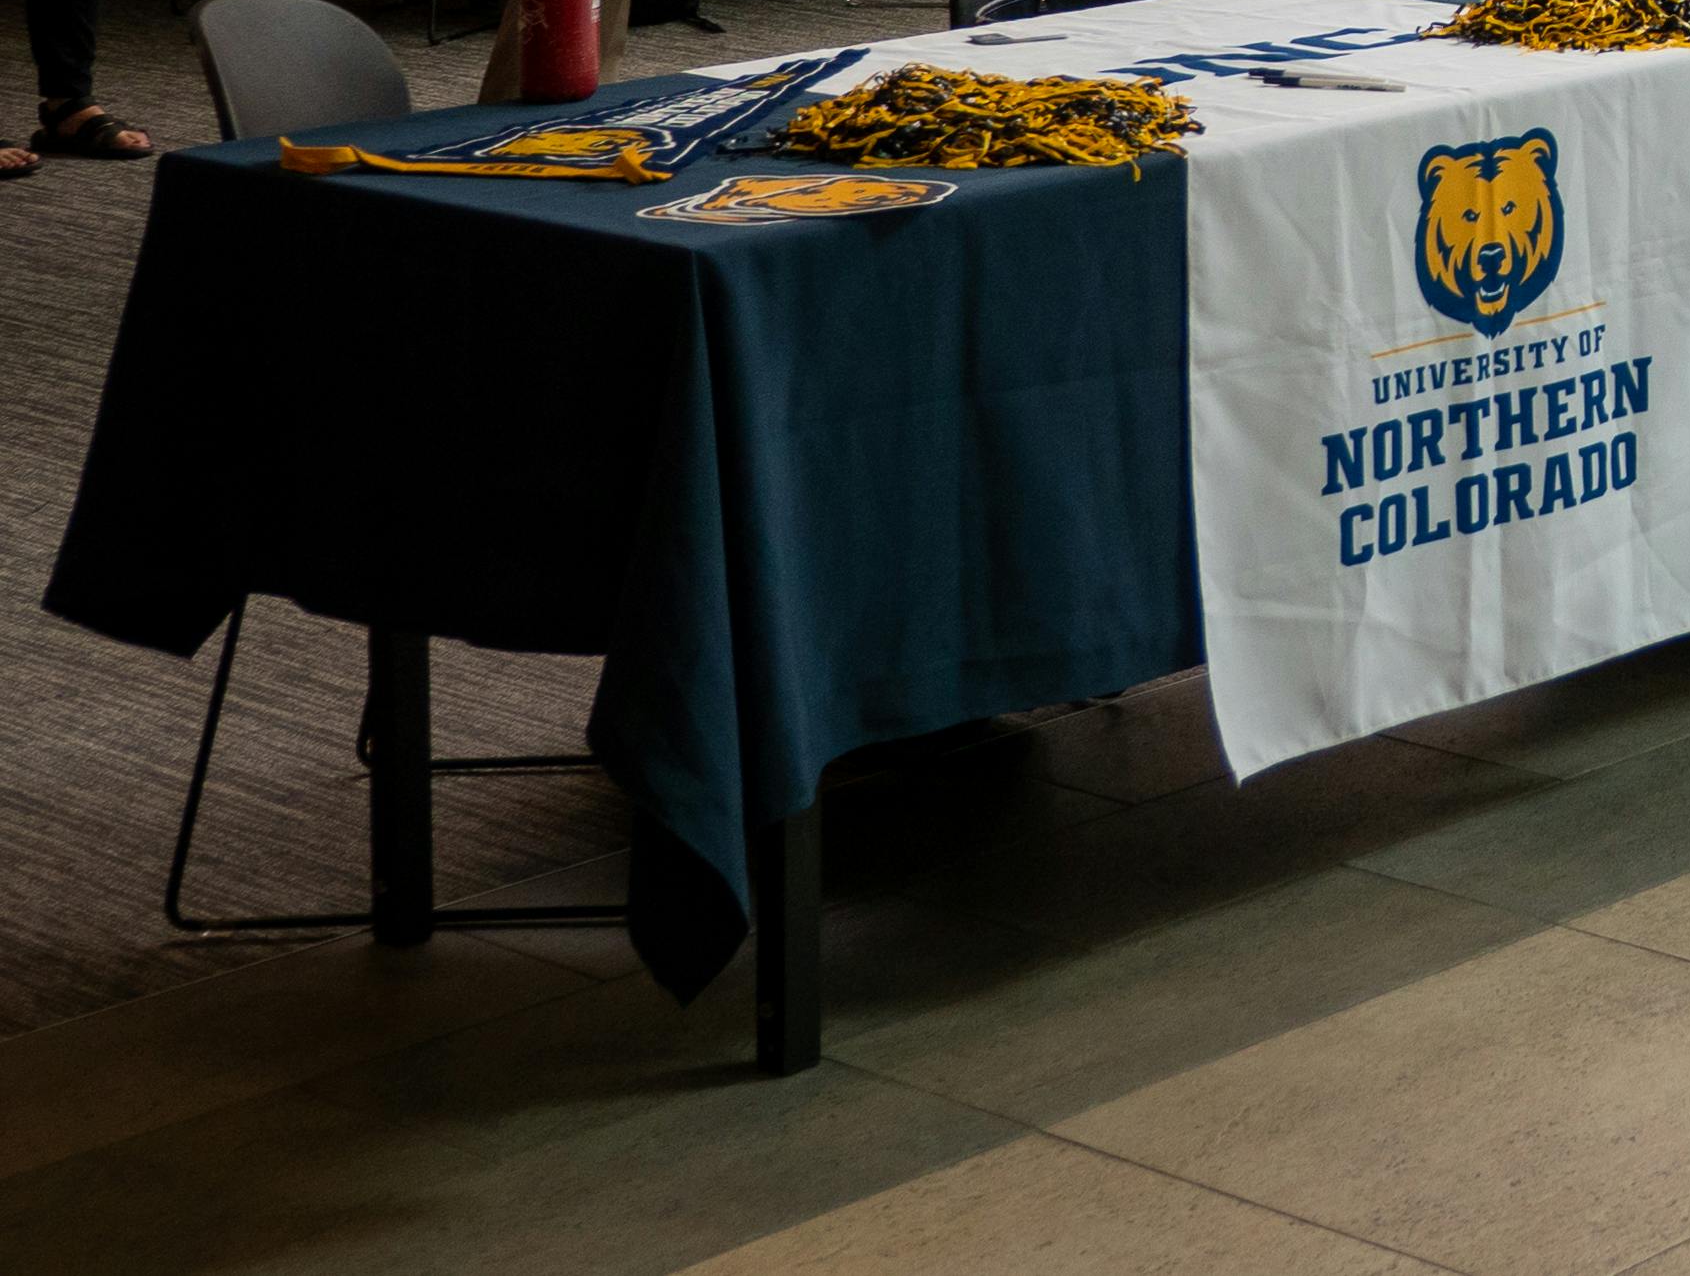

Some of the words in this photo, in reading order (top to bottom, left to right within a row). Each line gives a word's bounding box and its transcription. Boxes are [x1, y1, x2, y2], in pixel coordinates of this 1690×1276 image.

[1321, 355, 1653, 497] NORTHERN
[1371, 335, 1569, 405] UNIVERSITY
[1577, 324, 1606, 357] OF
[1339, 430, 1638, 568] COLORADO
